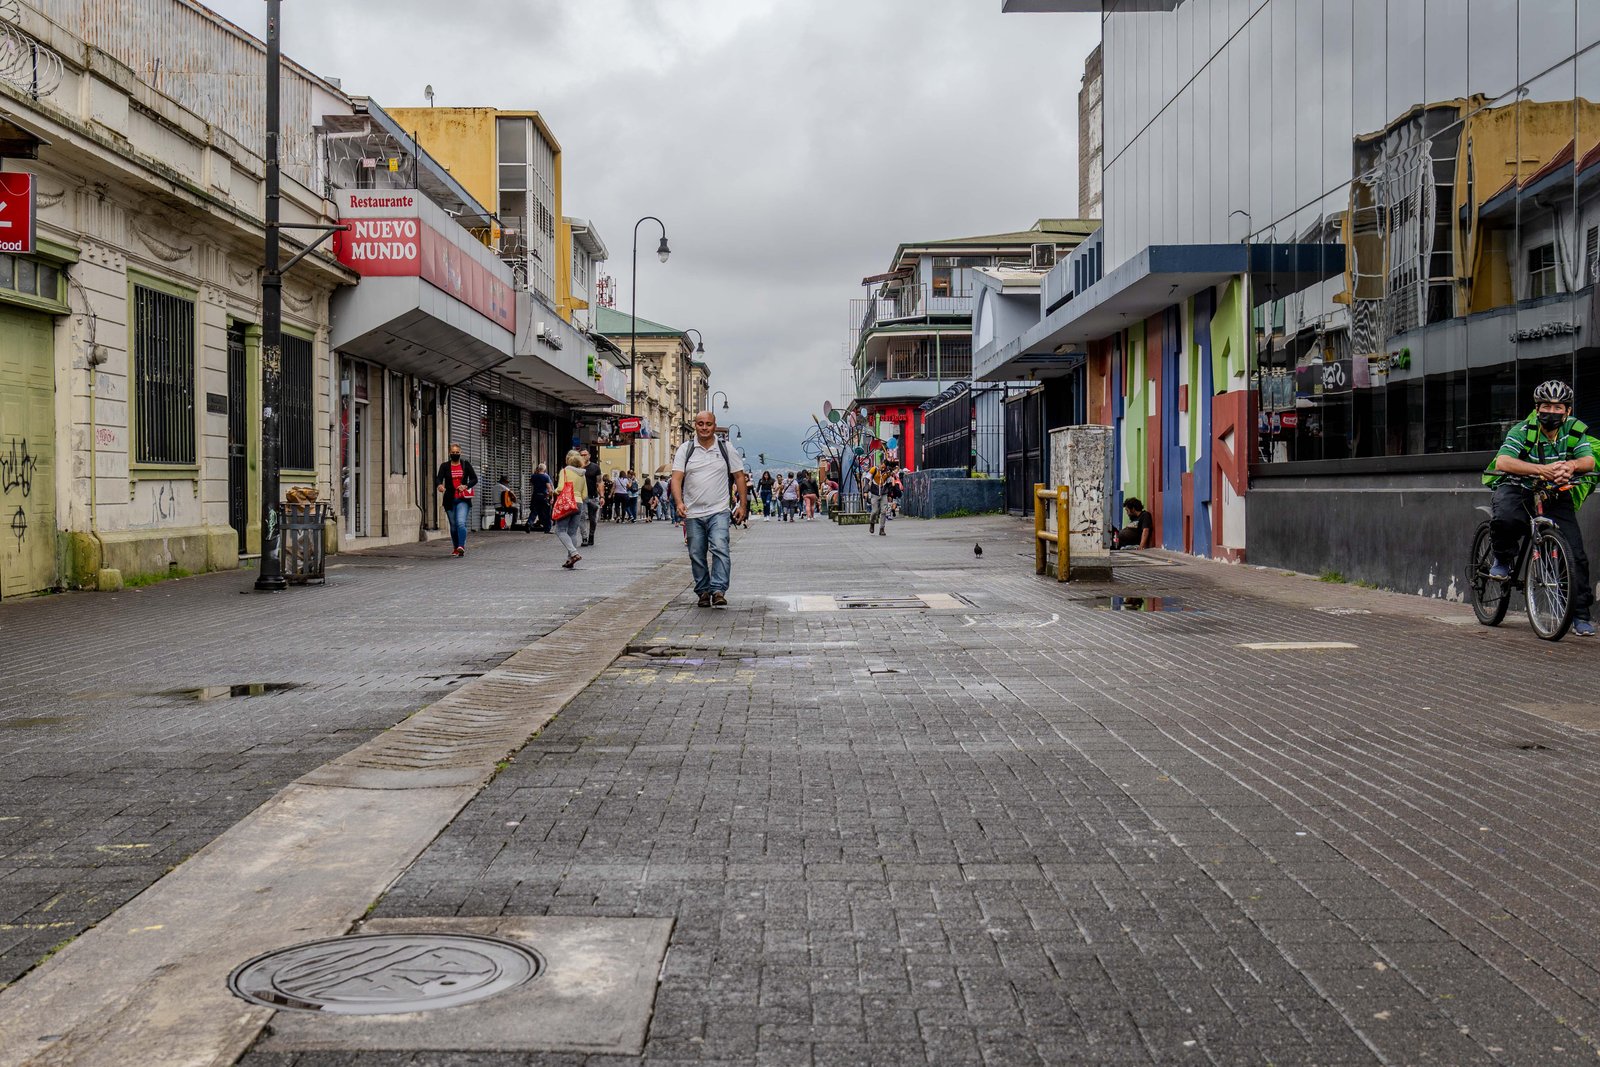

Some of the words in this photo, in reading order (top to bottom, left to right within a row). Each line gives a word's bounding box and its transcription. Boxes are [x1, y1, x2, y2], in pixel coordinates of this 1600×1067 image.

[350, 195, 413, 208] Restaurante
[355, 221, 417, 238] NUEVO
[0, 240, 22, 251] ood
[351, 242, 417, 260] MUNDO
